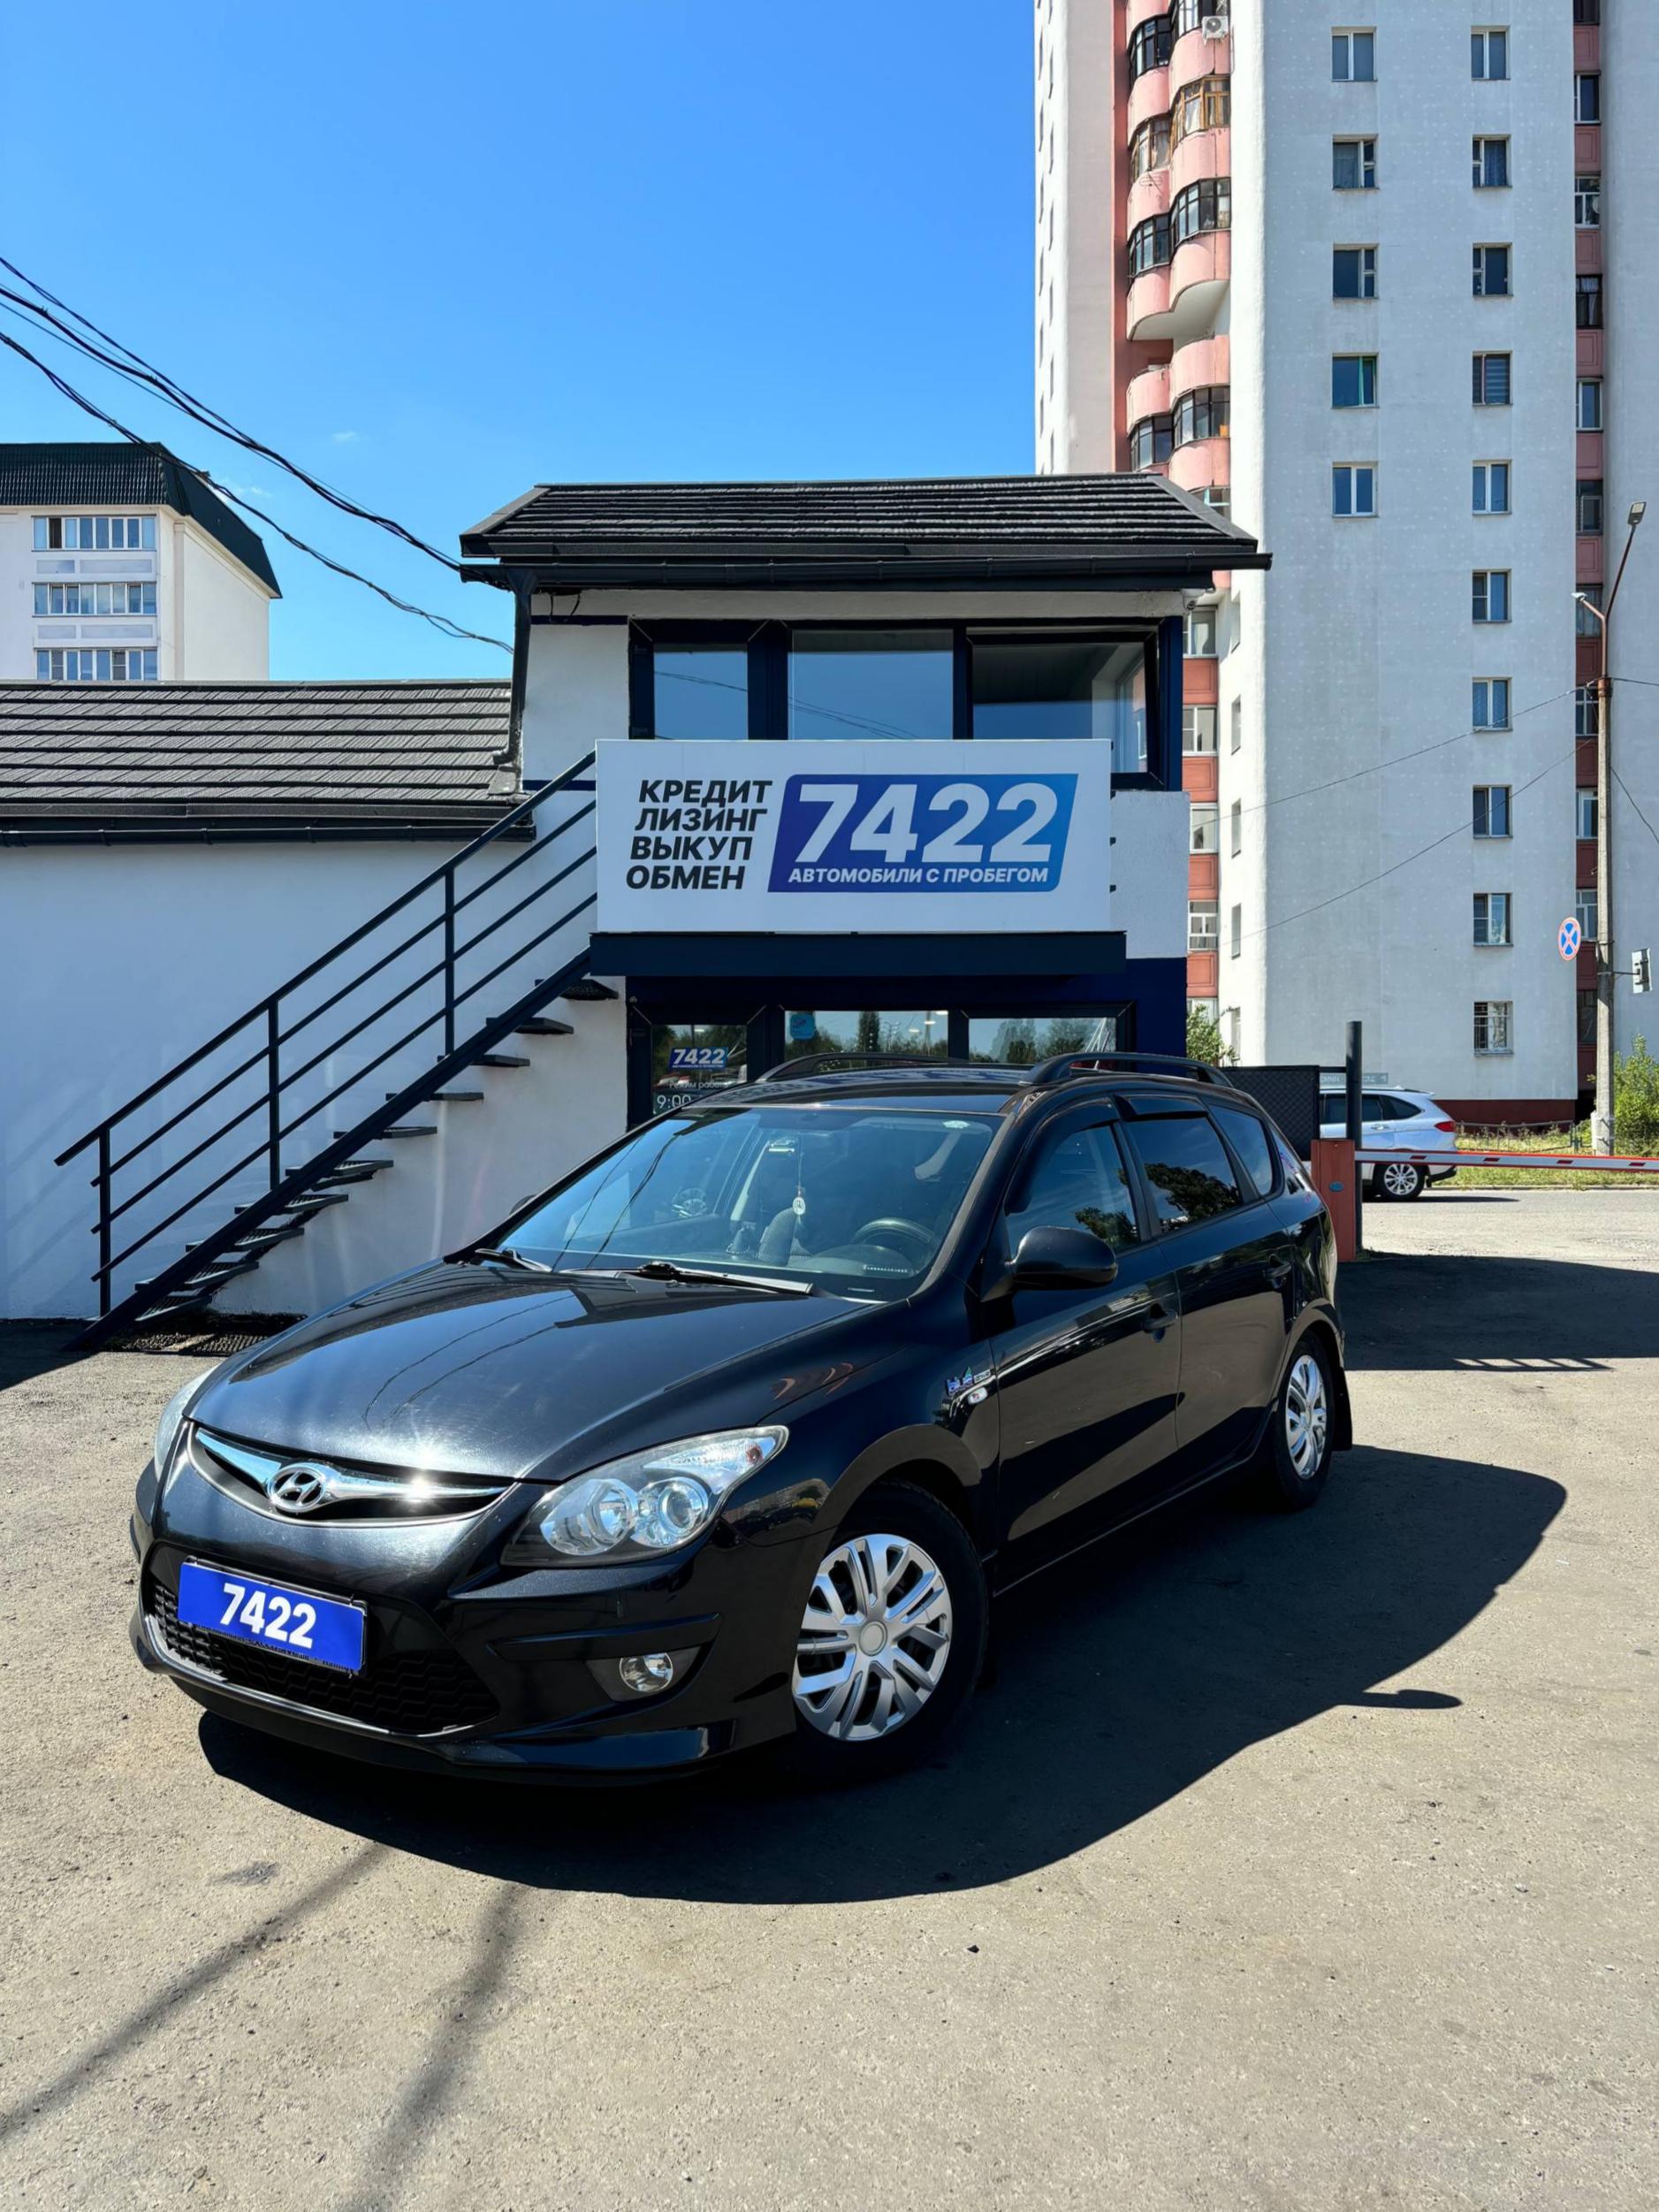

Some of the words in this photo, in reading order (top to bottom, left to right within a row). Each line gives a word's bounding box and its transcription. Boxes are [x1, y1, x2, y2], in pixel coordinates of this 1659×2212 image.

[638, 780, 773, 808] КРЕДИТ
[635, 808, 768, 833] ЛИЗИНГ
[795, 782, 1059, 864] 7422
[629, 836, 753, 861] ВЫКУП
[625, 865, 746, 890] ОБМЕН
[788, 867, 922, 883] АВТОМОБИЛИ
[926, 867, 940, 883] С
[943, 867, 1050, 883] ПРОБЕГОМ
[673, 1048, 726, 1064] 7422
[220, 1582, 317, 1650] 7422
